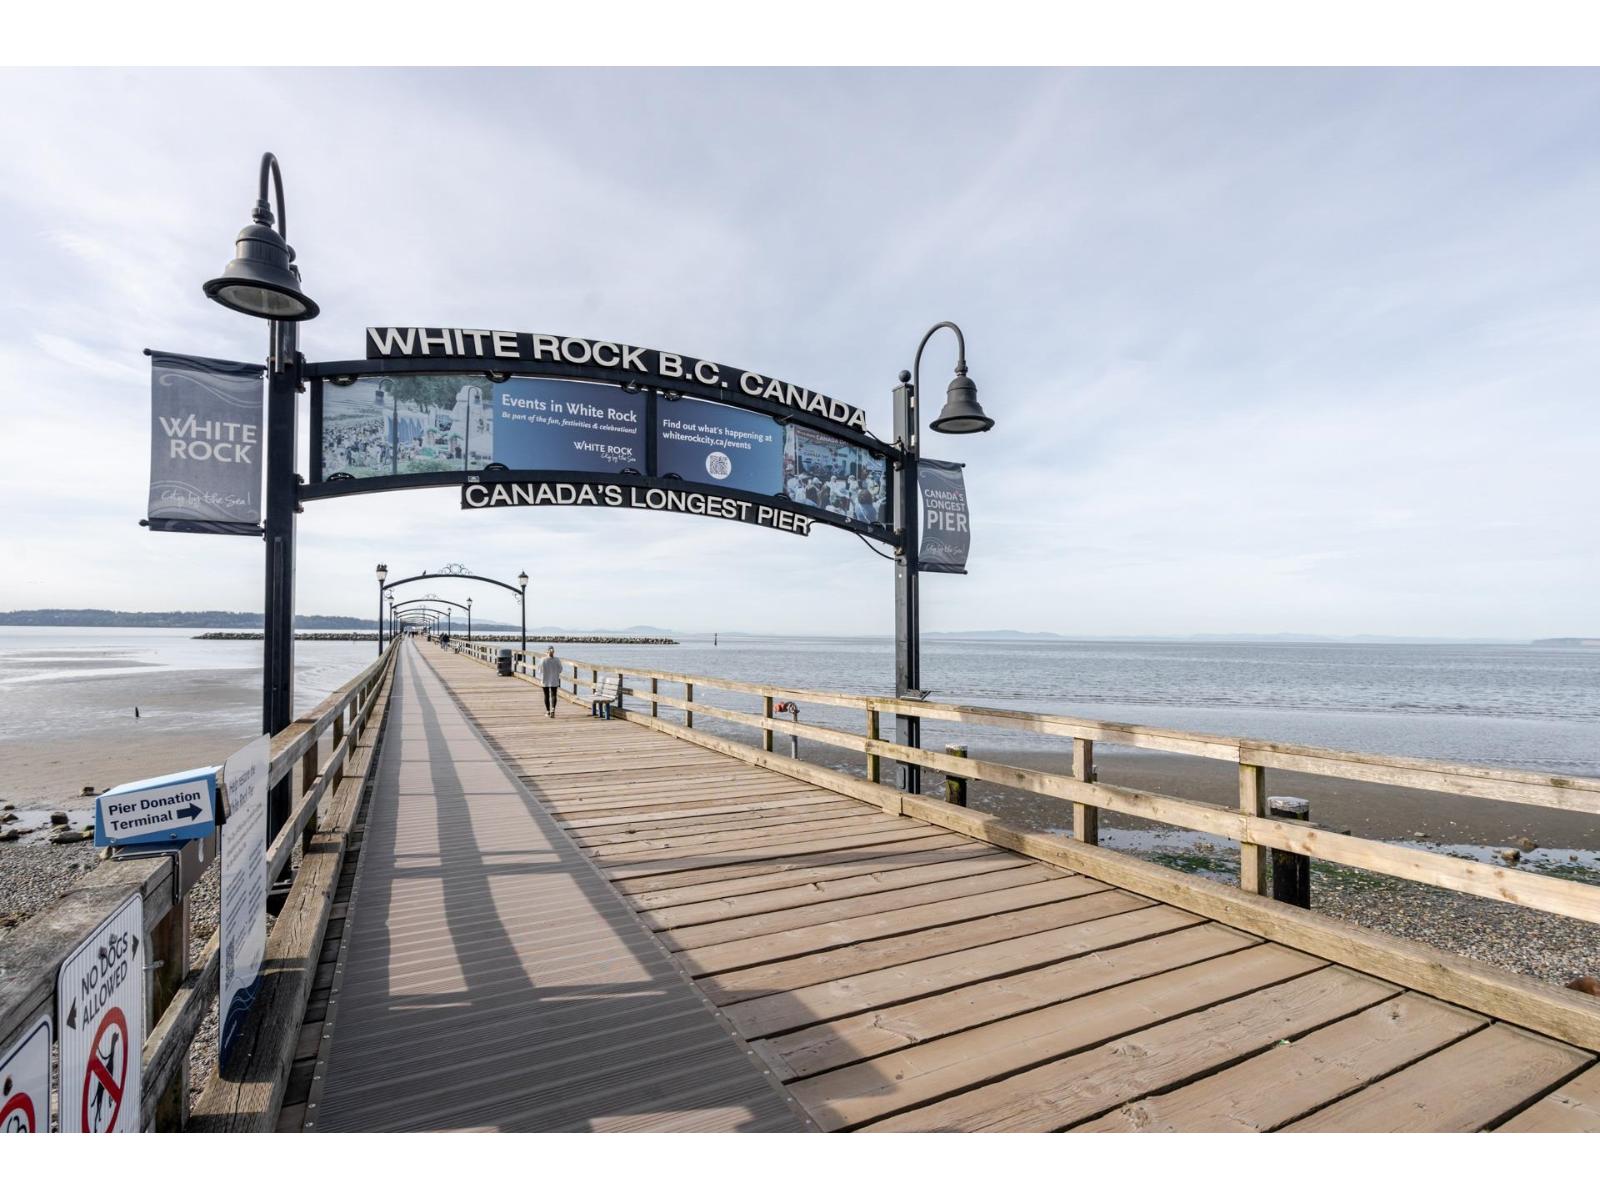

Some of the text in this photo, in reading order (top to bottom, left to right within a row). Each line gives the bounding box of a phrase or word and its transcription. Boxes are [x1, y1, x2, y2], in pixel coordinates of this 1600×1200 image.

[367, 328, 867, 432] WHITE ROCK B.C. CANADA
[502, 393, 638, 423] Events in White Rock
[502, 411, 511, 419] Be
[512, 413, 527, 421] part
[528, 415, 537, 423] of
[536, 415, 547, 423] the
[560, 418, 591, 429] festivities
[159, 414, 257, 444] WHITE
[663, 419, 773, 443] Find out what's happening at
[663, 430, 752, 450] whiterockcity.ca/events
[170, 439, 252, 464] ROCK
[573, 440, 633, 456] WHITE ROCK
[203, 490, 222, 505] the
[924, 488, 964, 502] CANADA'S
[926, 499, 966, 513] LONGEST
[465, 483, 808, 534] CANADA'S LONGEST PIER
[927, 509, 968, 533] PIER
[108, 791, 201, 816] Pier Donation
[110, 810, 172, 831] Terminal
[82, 931, 128, 1001] NO DOGS
[82, 960, 128, 1032] ALLOWED
